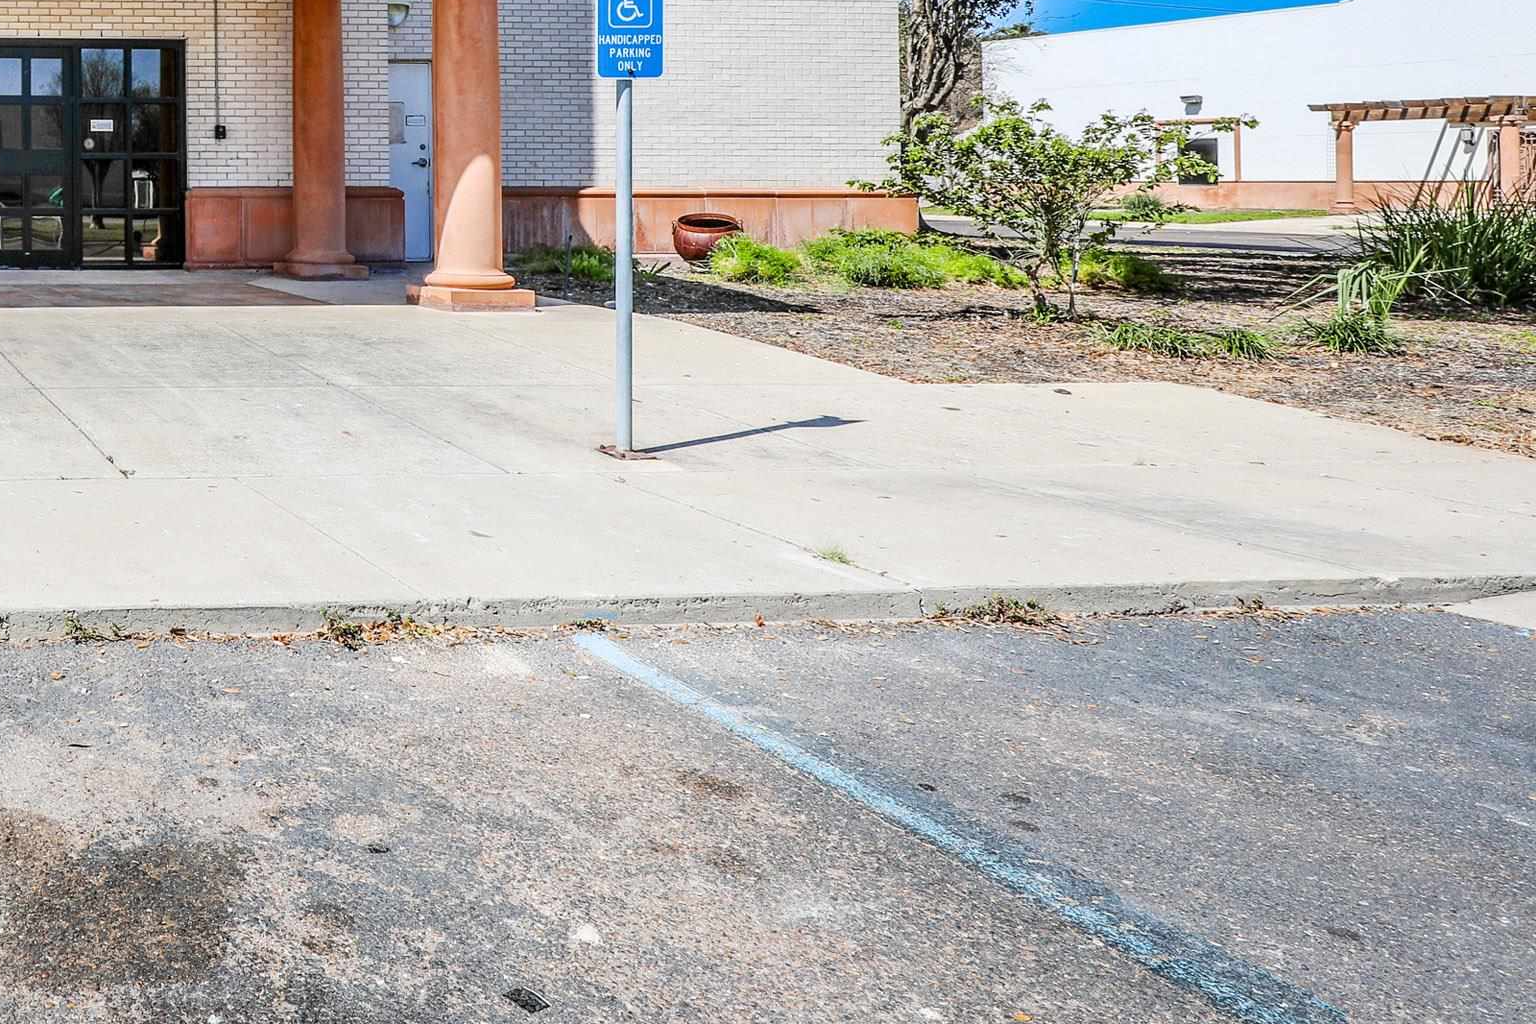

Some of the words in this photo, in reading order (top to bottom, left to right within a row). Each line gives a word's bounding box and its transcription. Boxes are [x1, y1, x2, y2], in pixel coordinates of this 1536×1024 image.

[598, 34, 662, 45] HANDICAPPED
[609, 47, 651, 58] PARKING
[617, 60, 643, 71] ONLY
